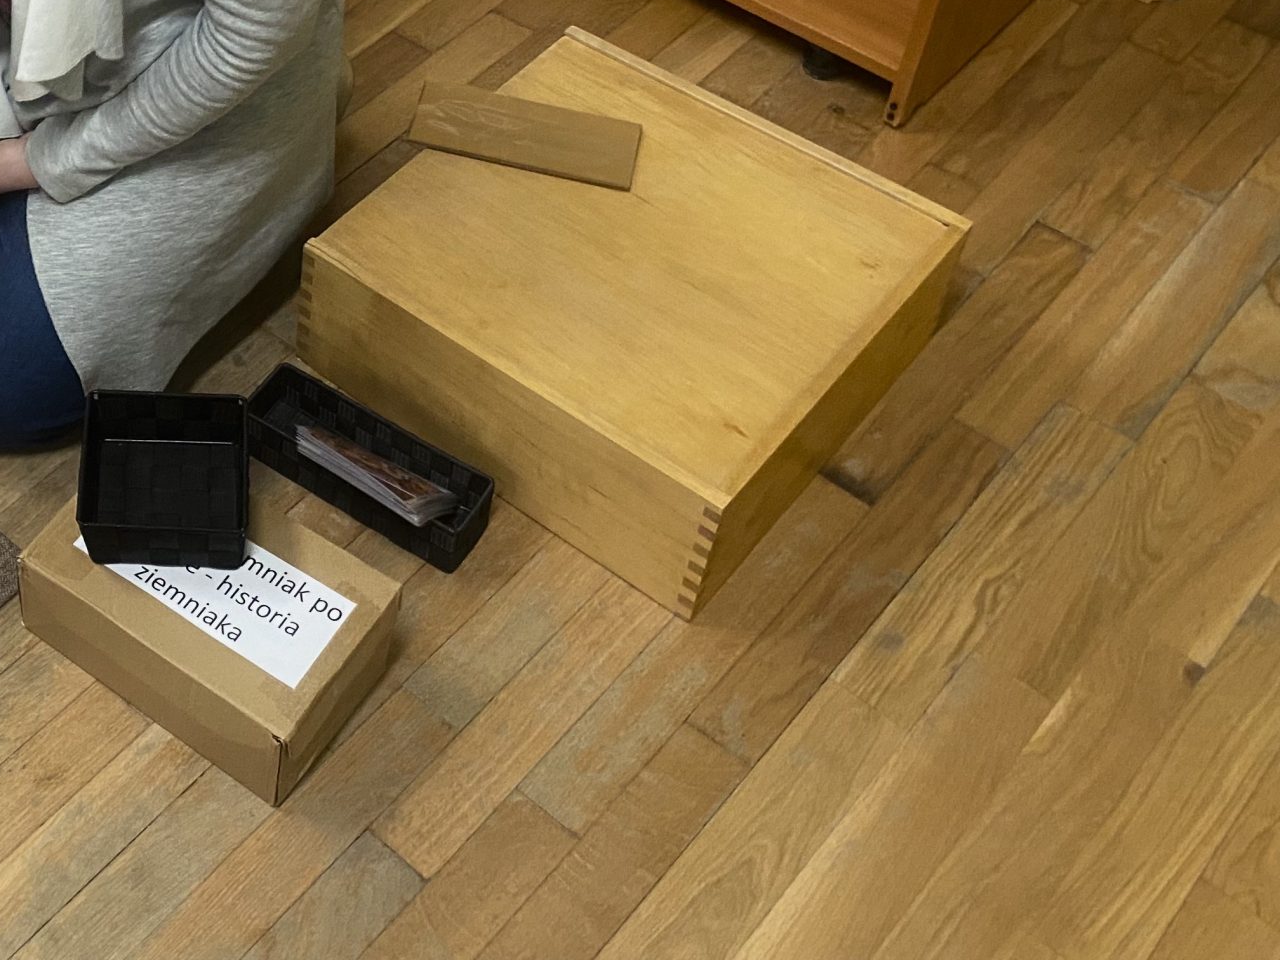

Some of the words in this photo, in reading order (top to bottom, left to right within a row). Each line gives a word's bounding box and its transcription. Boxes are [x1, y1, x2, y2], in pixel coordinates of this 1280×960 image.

[133, 566, 242, 642] ziemniaka
[216, 574, 300, 637] historia
[309, 597, 343, 622] po
